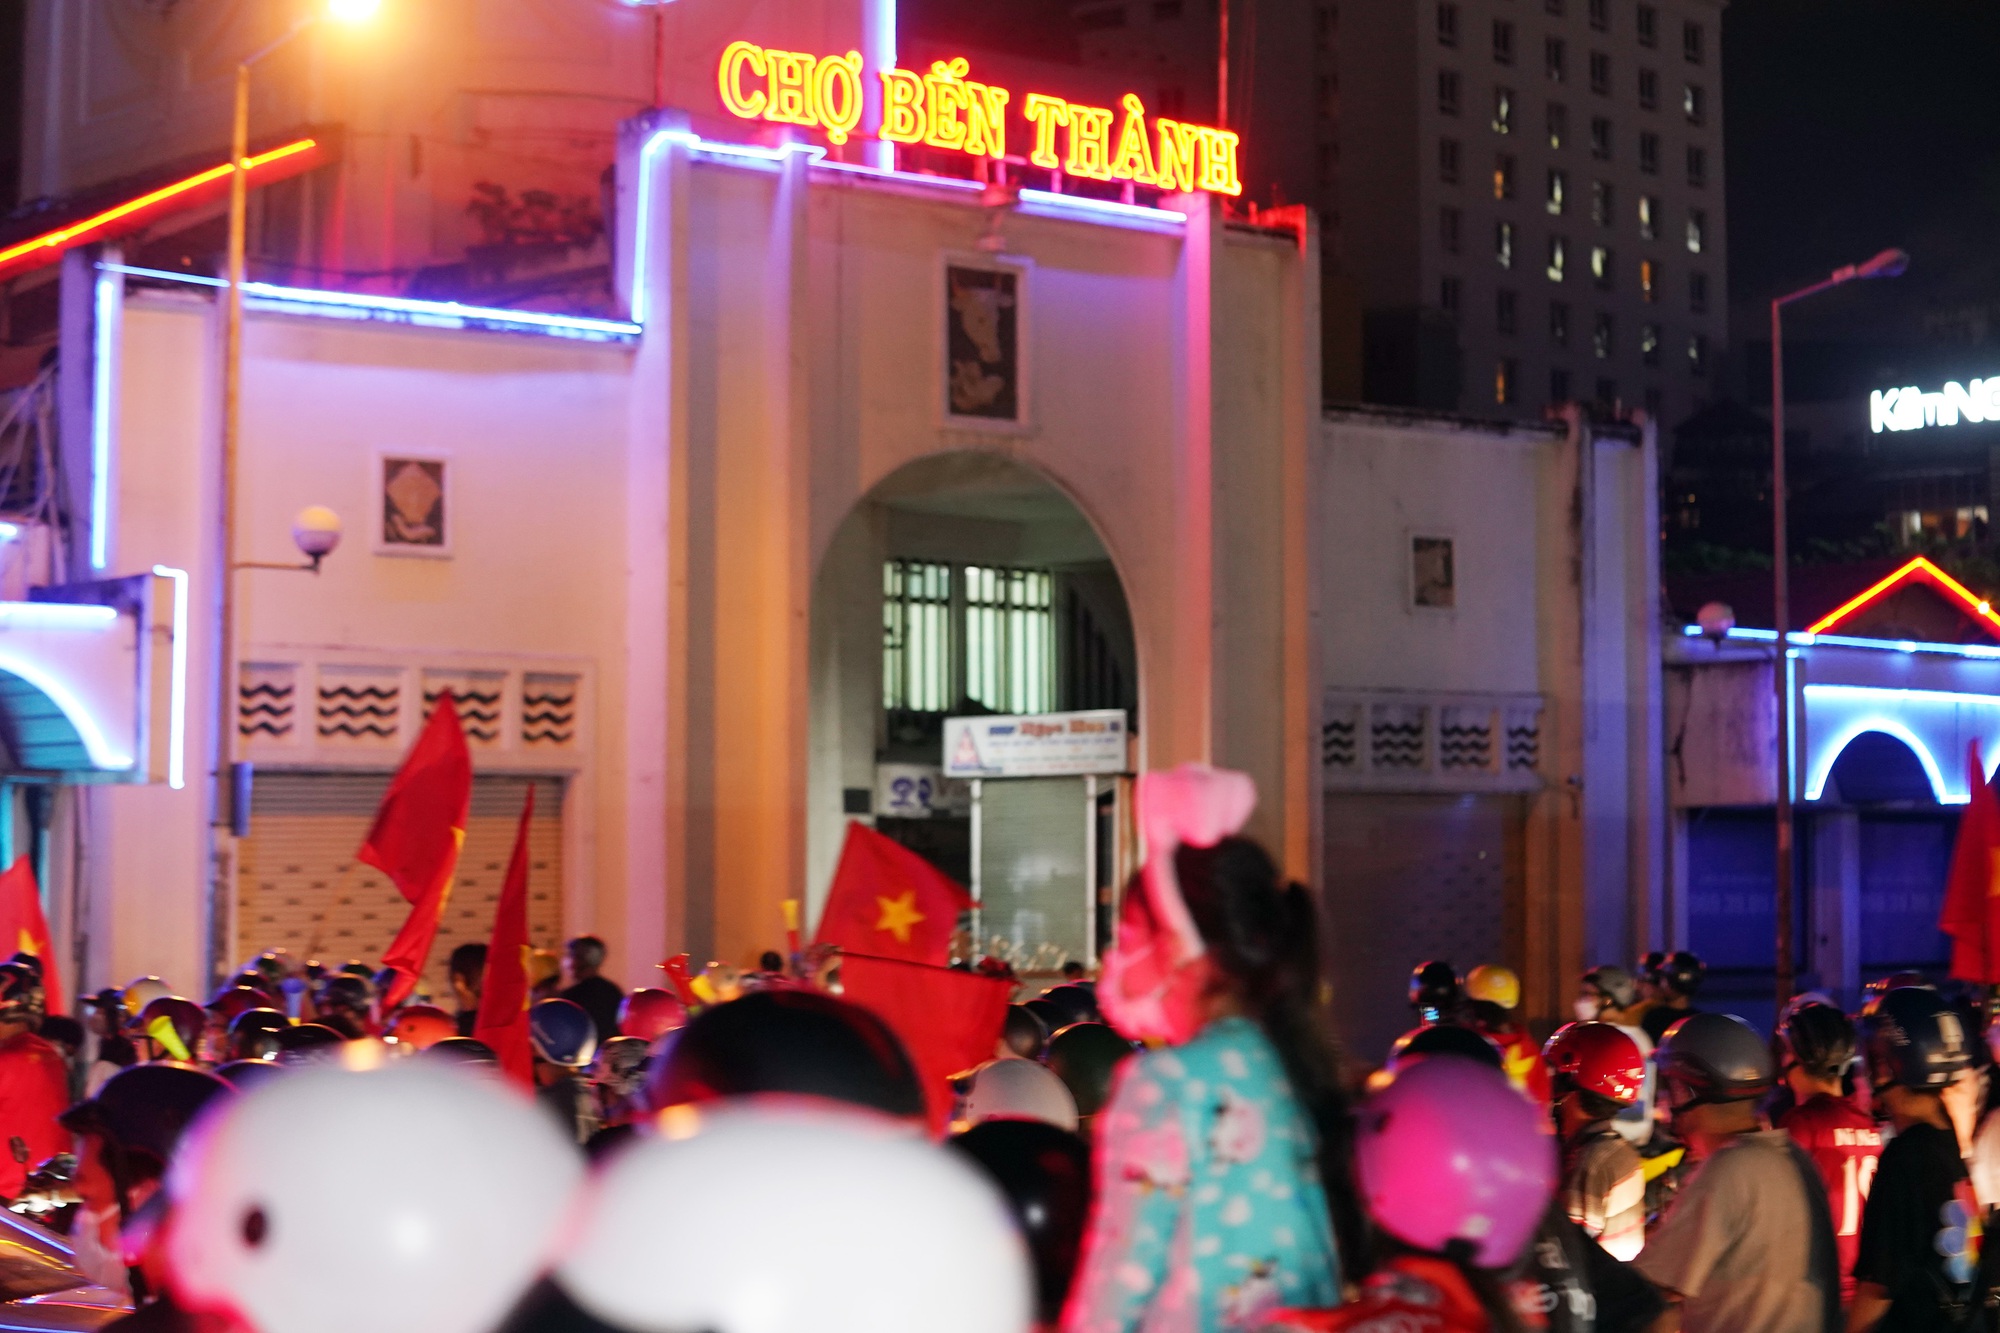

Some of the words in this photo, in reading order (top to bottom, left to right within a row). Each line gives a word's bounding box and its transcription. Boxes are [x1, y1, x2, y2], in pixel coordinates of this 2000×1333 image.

[717, 40, 864, 146] CHỢ
[878, 57, 1010, 160] BẾN
[1023, 92, 1243, 197] THÀNH
